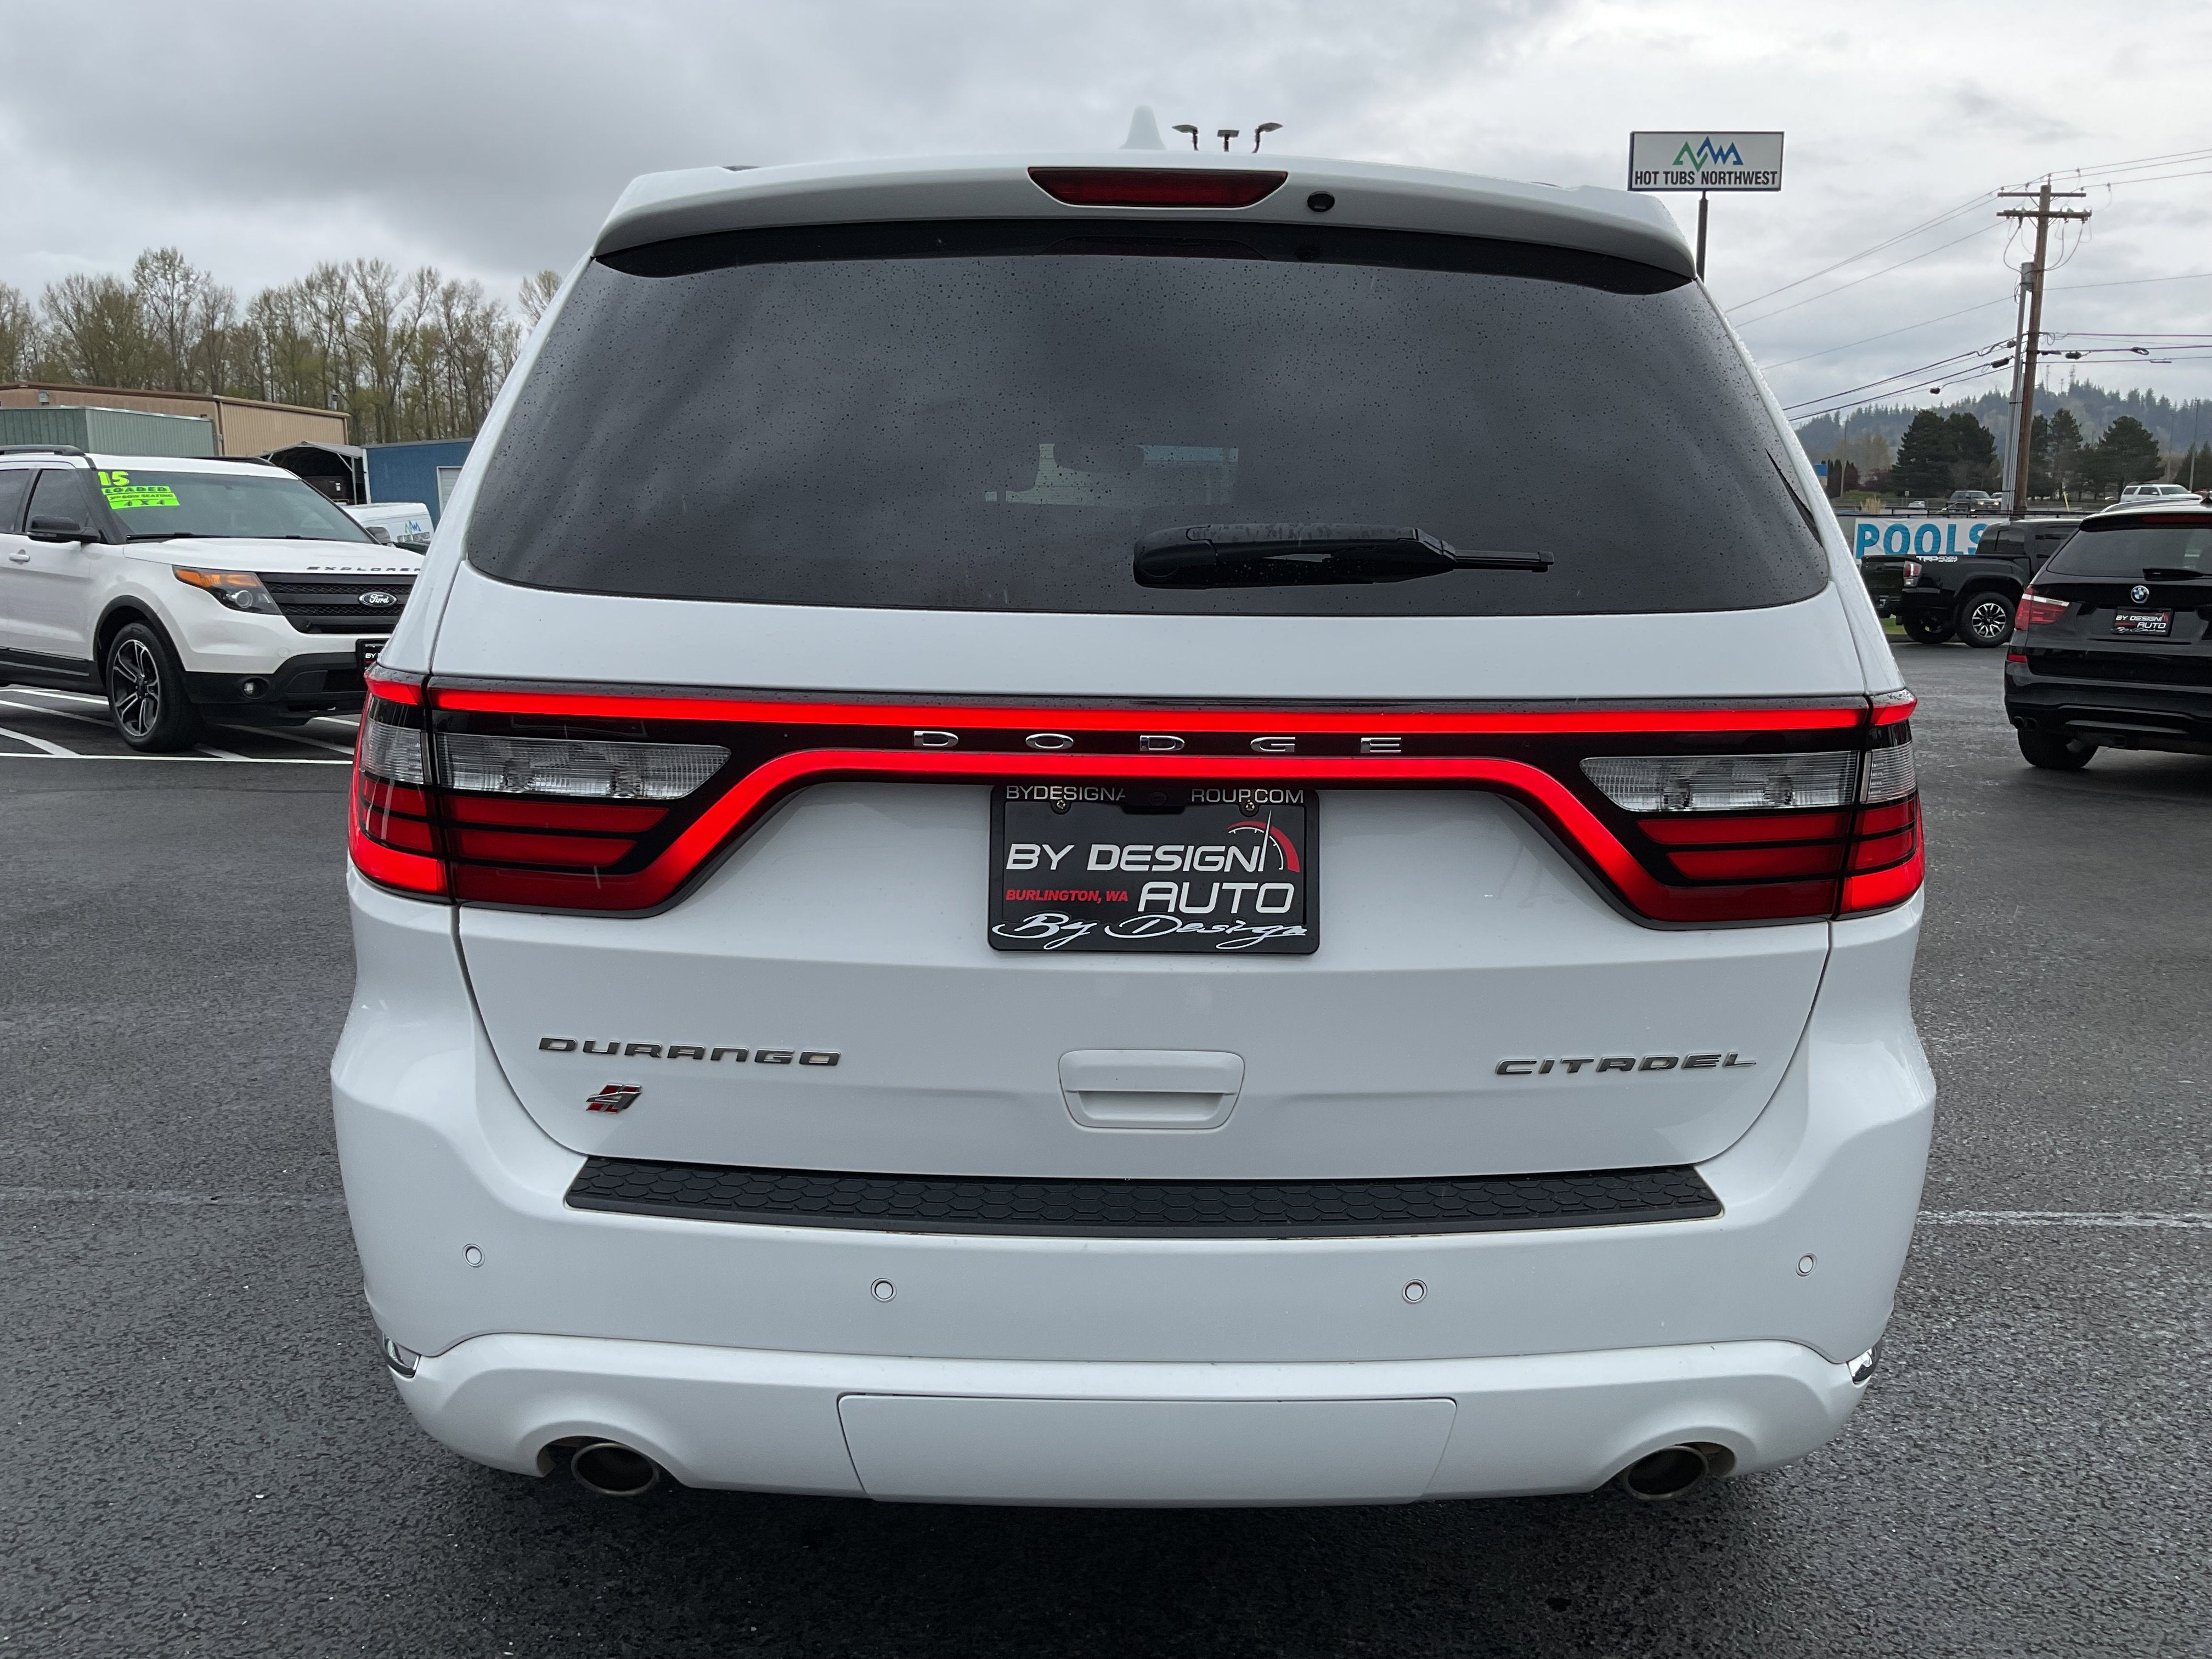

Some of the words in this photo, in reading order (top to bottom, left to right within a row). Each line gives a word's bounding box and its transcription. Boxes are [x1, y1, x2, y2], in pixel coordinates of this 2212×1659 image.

[1635, 171, 1659, 185] HOT
[1663, 171, 1695, 185] TUBS
[1701, 171, 1778, 185] NORTHWEST
[98, 471, 130, 486] 15
[369, 594, 390, 603] Ford
[913, 730, 1402, 753] DODGE
[1006, 843, 1074, 871] BY
[1087, 844, 1262, 872] DESIGN
[1005, 889, 1102, 904] BURLINGTON,
[1106, 890, 1128, 902] WA
[1137, 881, 1295, 914] AUTO
[991, 913, 1099, 950] By
[1104, 914, 1308, 950] Design
[538, 1036, 841, 1066] DURANGO
[1494, 1052, 1757, 1075] CITADEL
